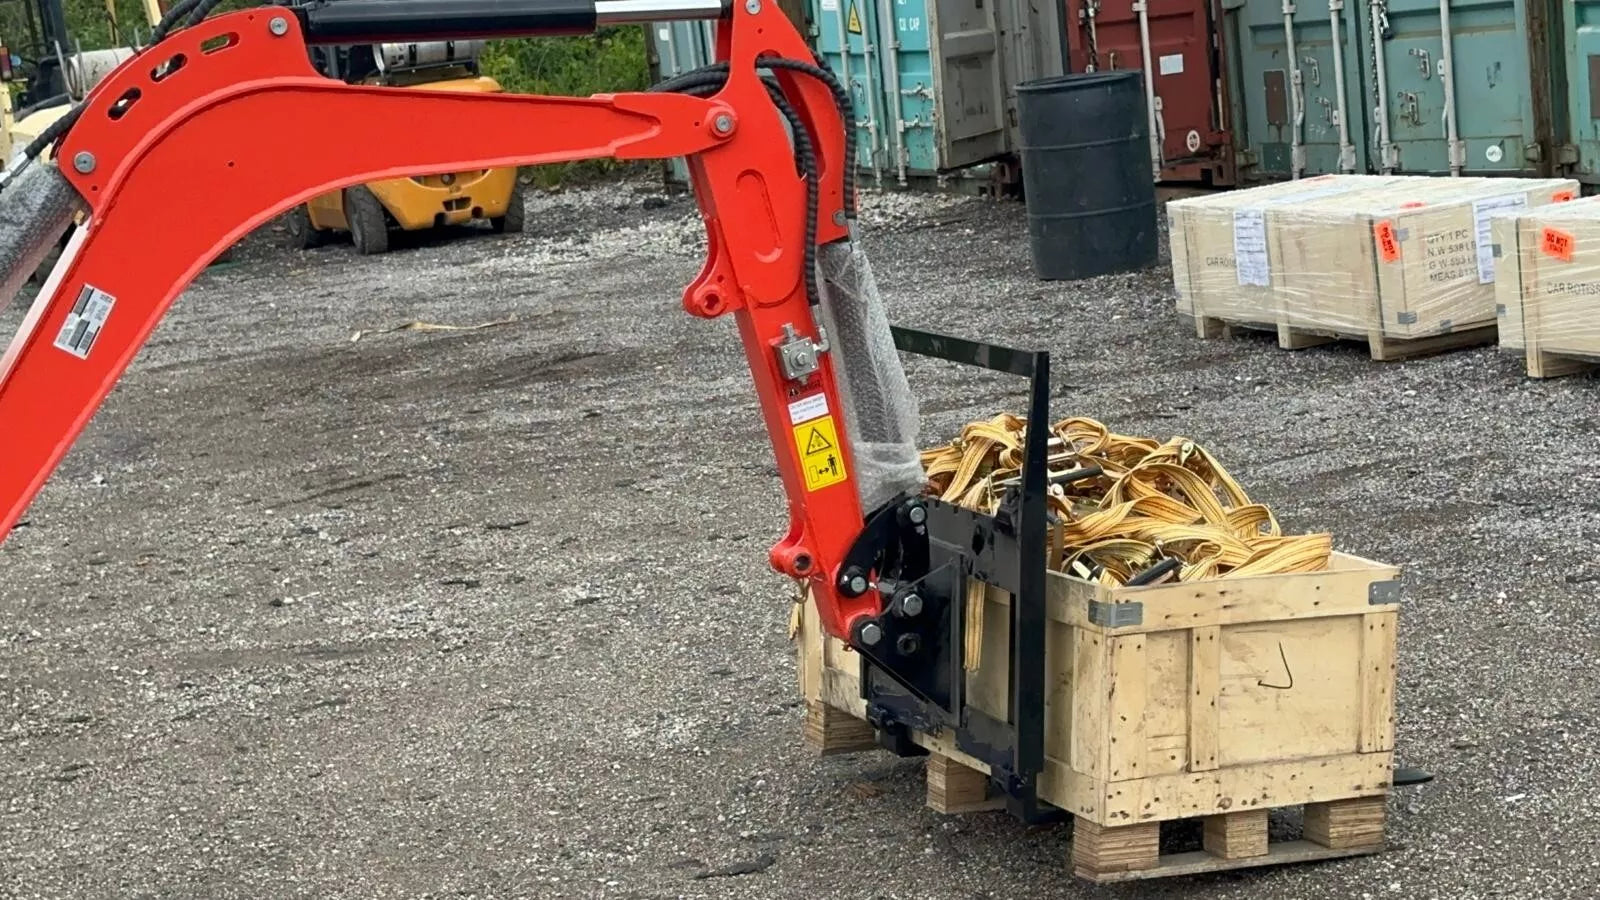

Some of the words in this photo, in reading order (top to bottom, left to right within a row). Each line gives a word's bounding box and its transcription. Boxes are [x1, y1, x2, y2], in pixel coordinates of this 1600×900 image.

[1455, 229, 1468, 239] PC
[1547, 233, 1554, 243] DO
[1547, 282, 1565, 294] CAR
